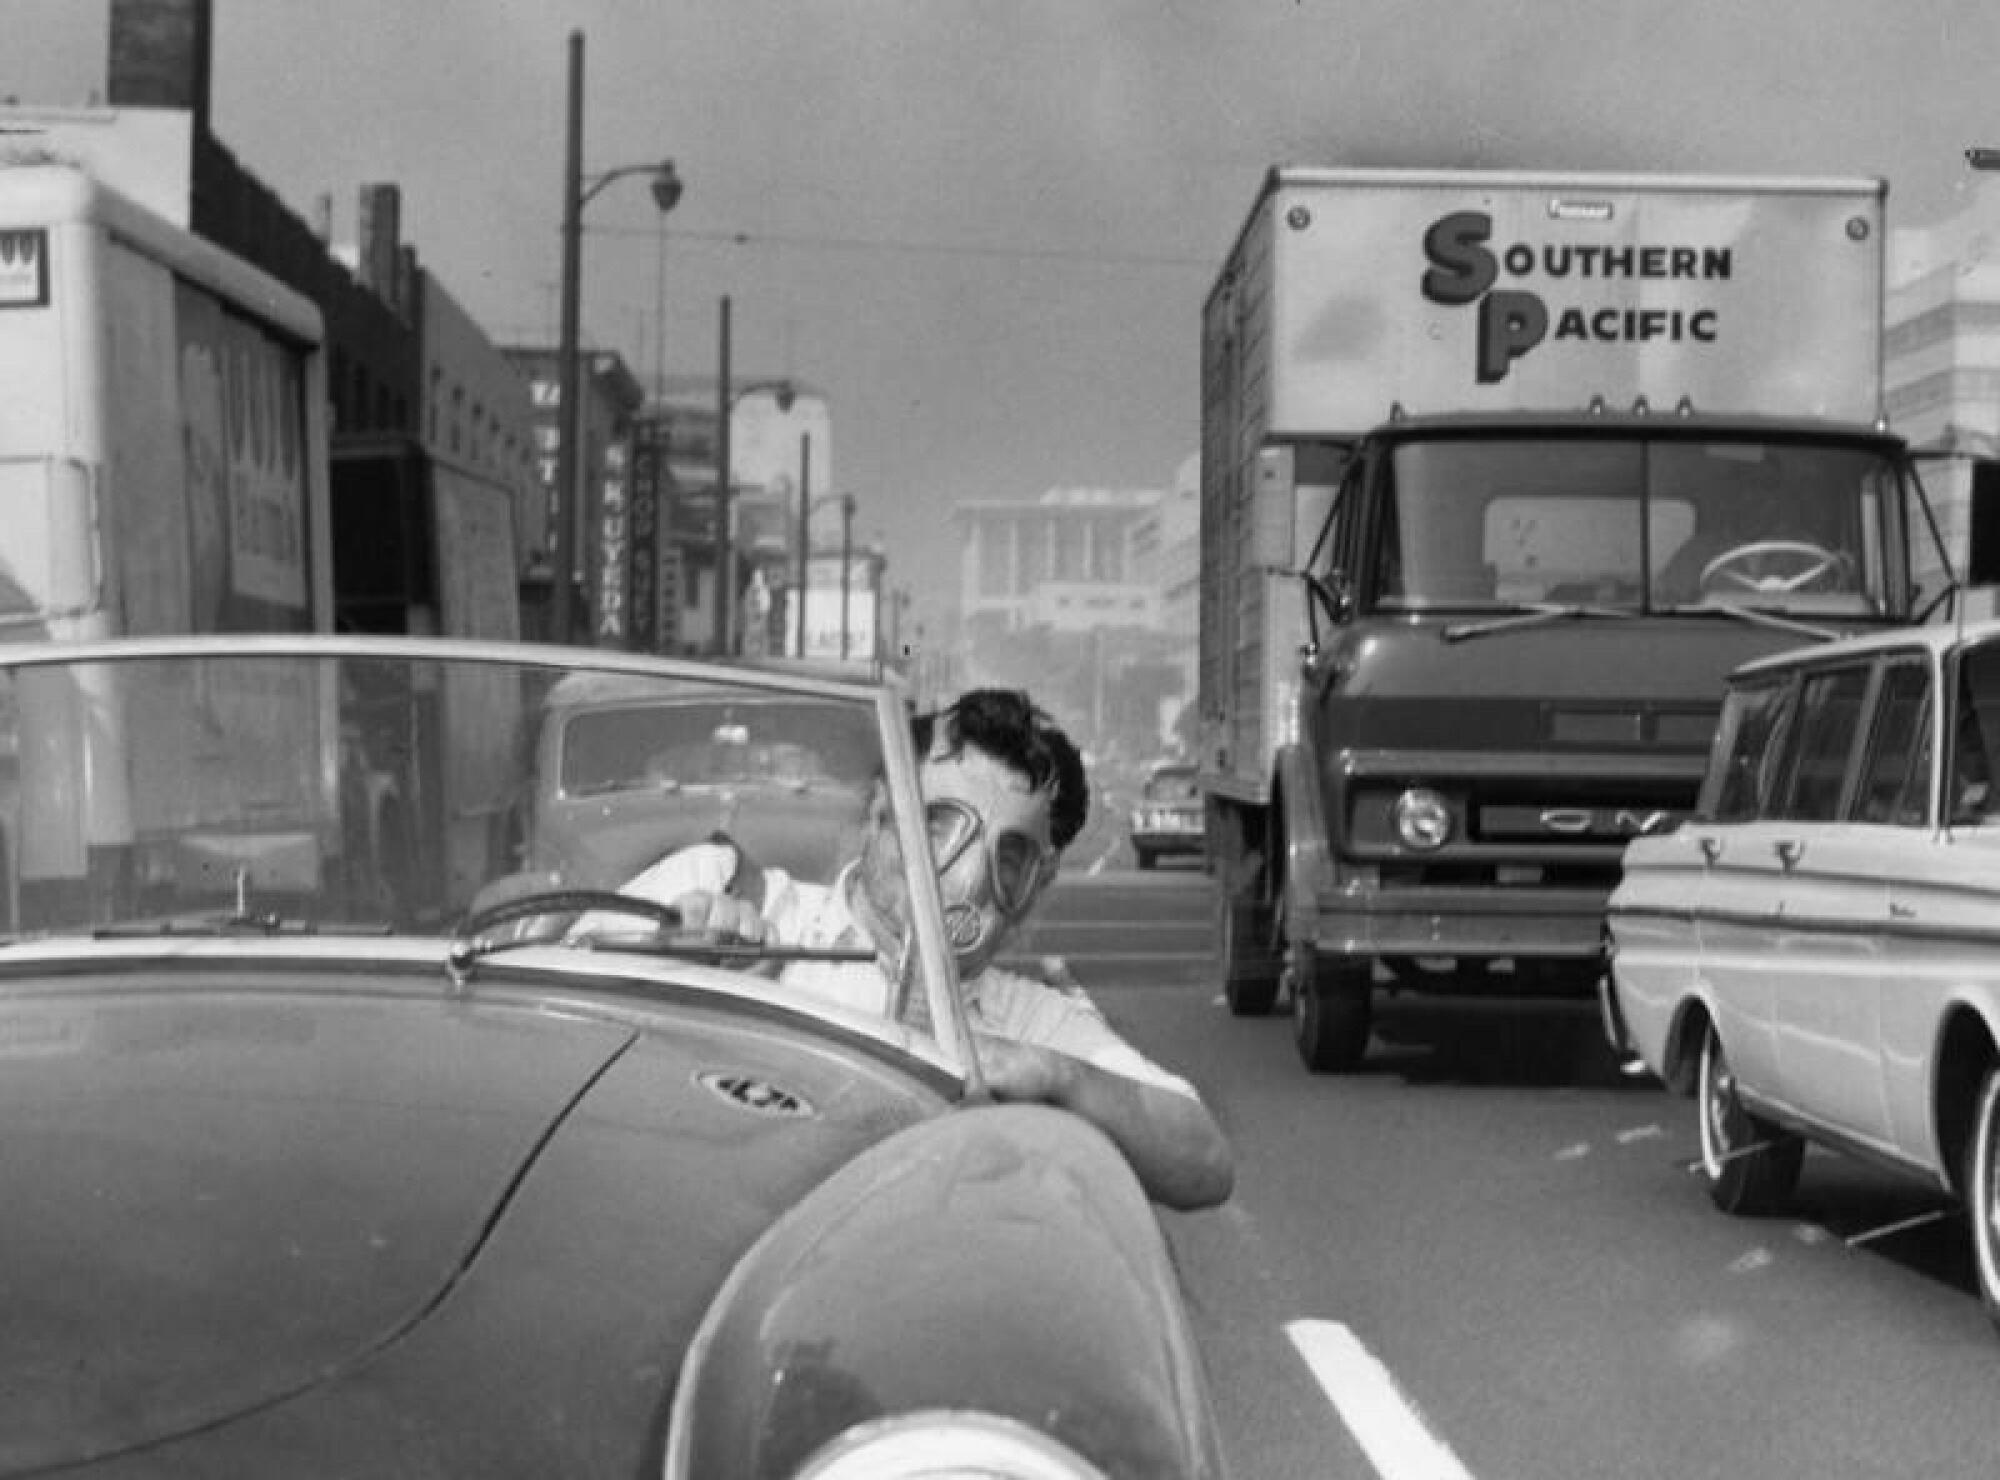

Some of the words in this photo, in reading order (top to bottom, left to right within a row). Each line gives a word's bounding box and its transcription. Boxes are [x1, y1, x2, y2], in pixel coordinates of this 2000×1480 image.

[1421, 210, 1732, 306] SOUTHERN
[1475, 289, 1718, 385] PACIFIC
[1540, 808, 1669, 833] GM
